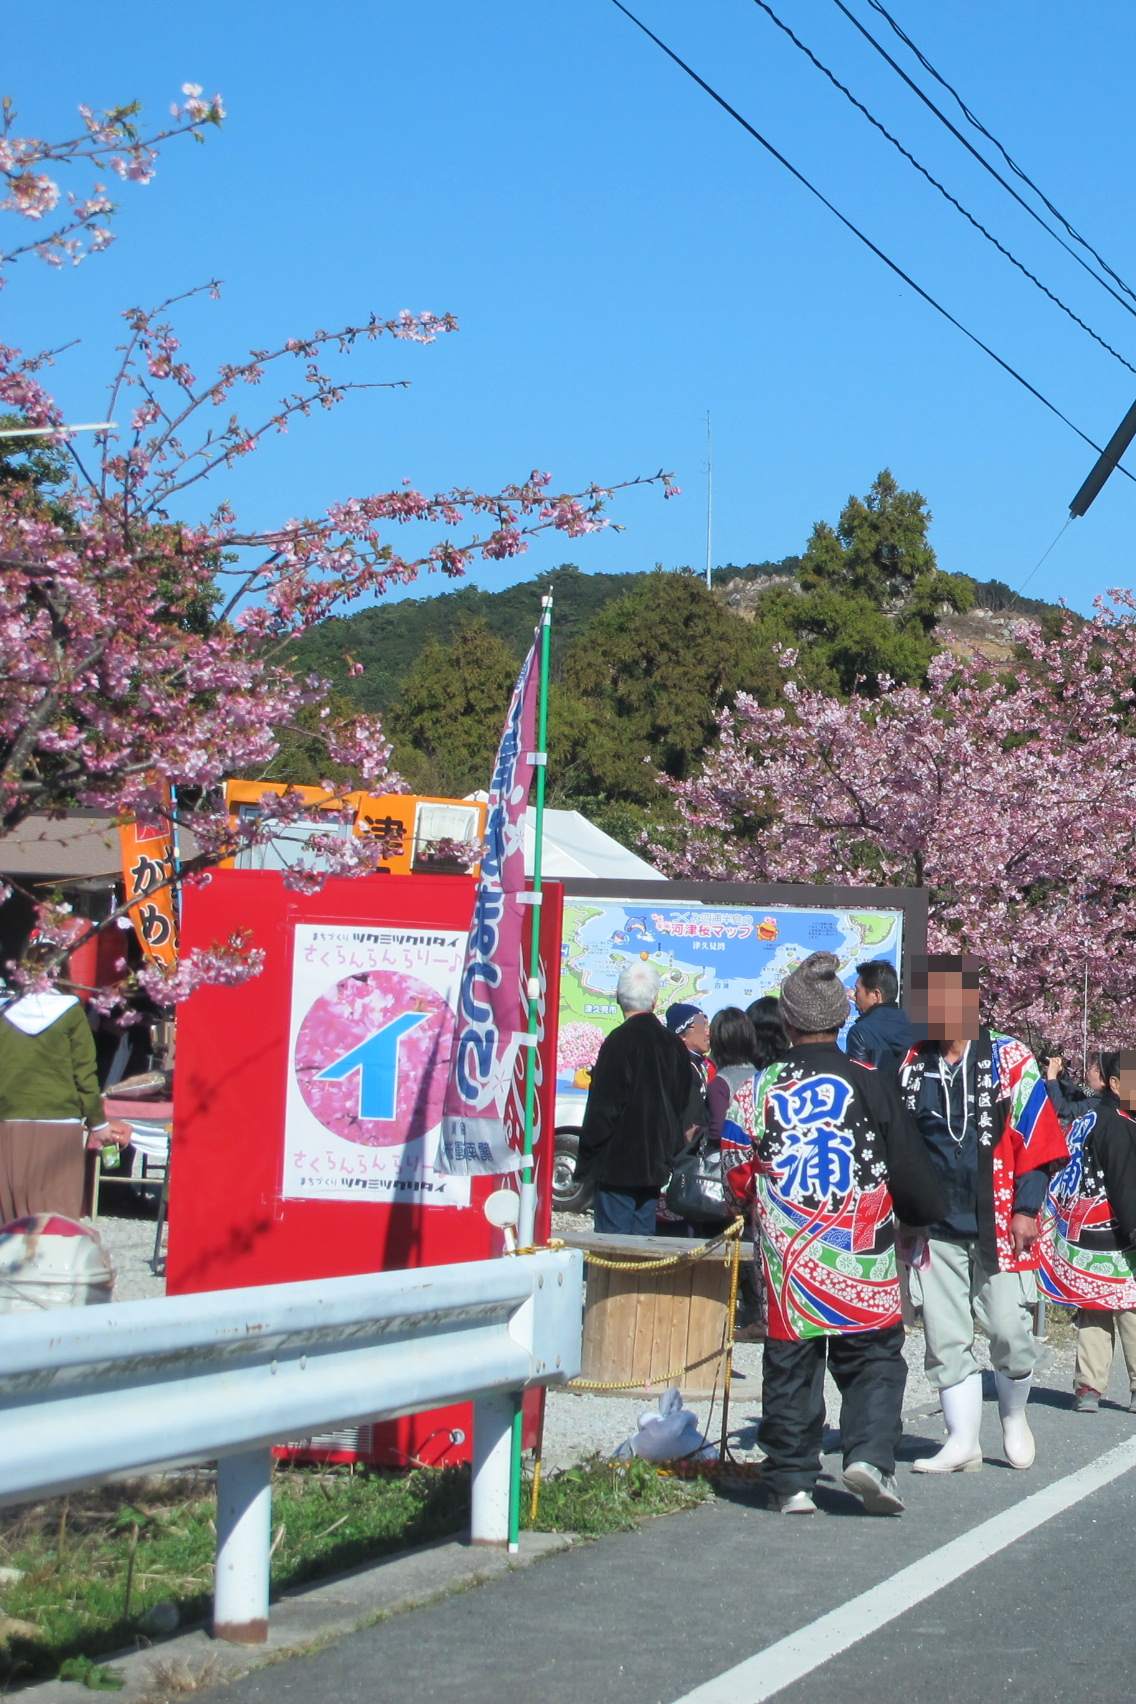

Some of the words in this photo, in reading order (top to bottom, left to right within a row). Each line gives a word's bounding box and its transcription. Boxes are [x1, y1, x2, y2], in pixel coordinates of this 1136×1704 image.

[352, 932, 460, 948] ツクミツクリタイ
[669, 922, 754, 939] 河津桜マップ
[313, 1010, 435, 1121] イ
[976, 1058, 993, 1147] 四浦区長会
[769, 1073, 856, 1200] 四浦
